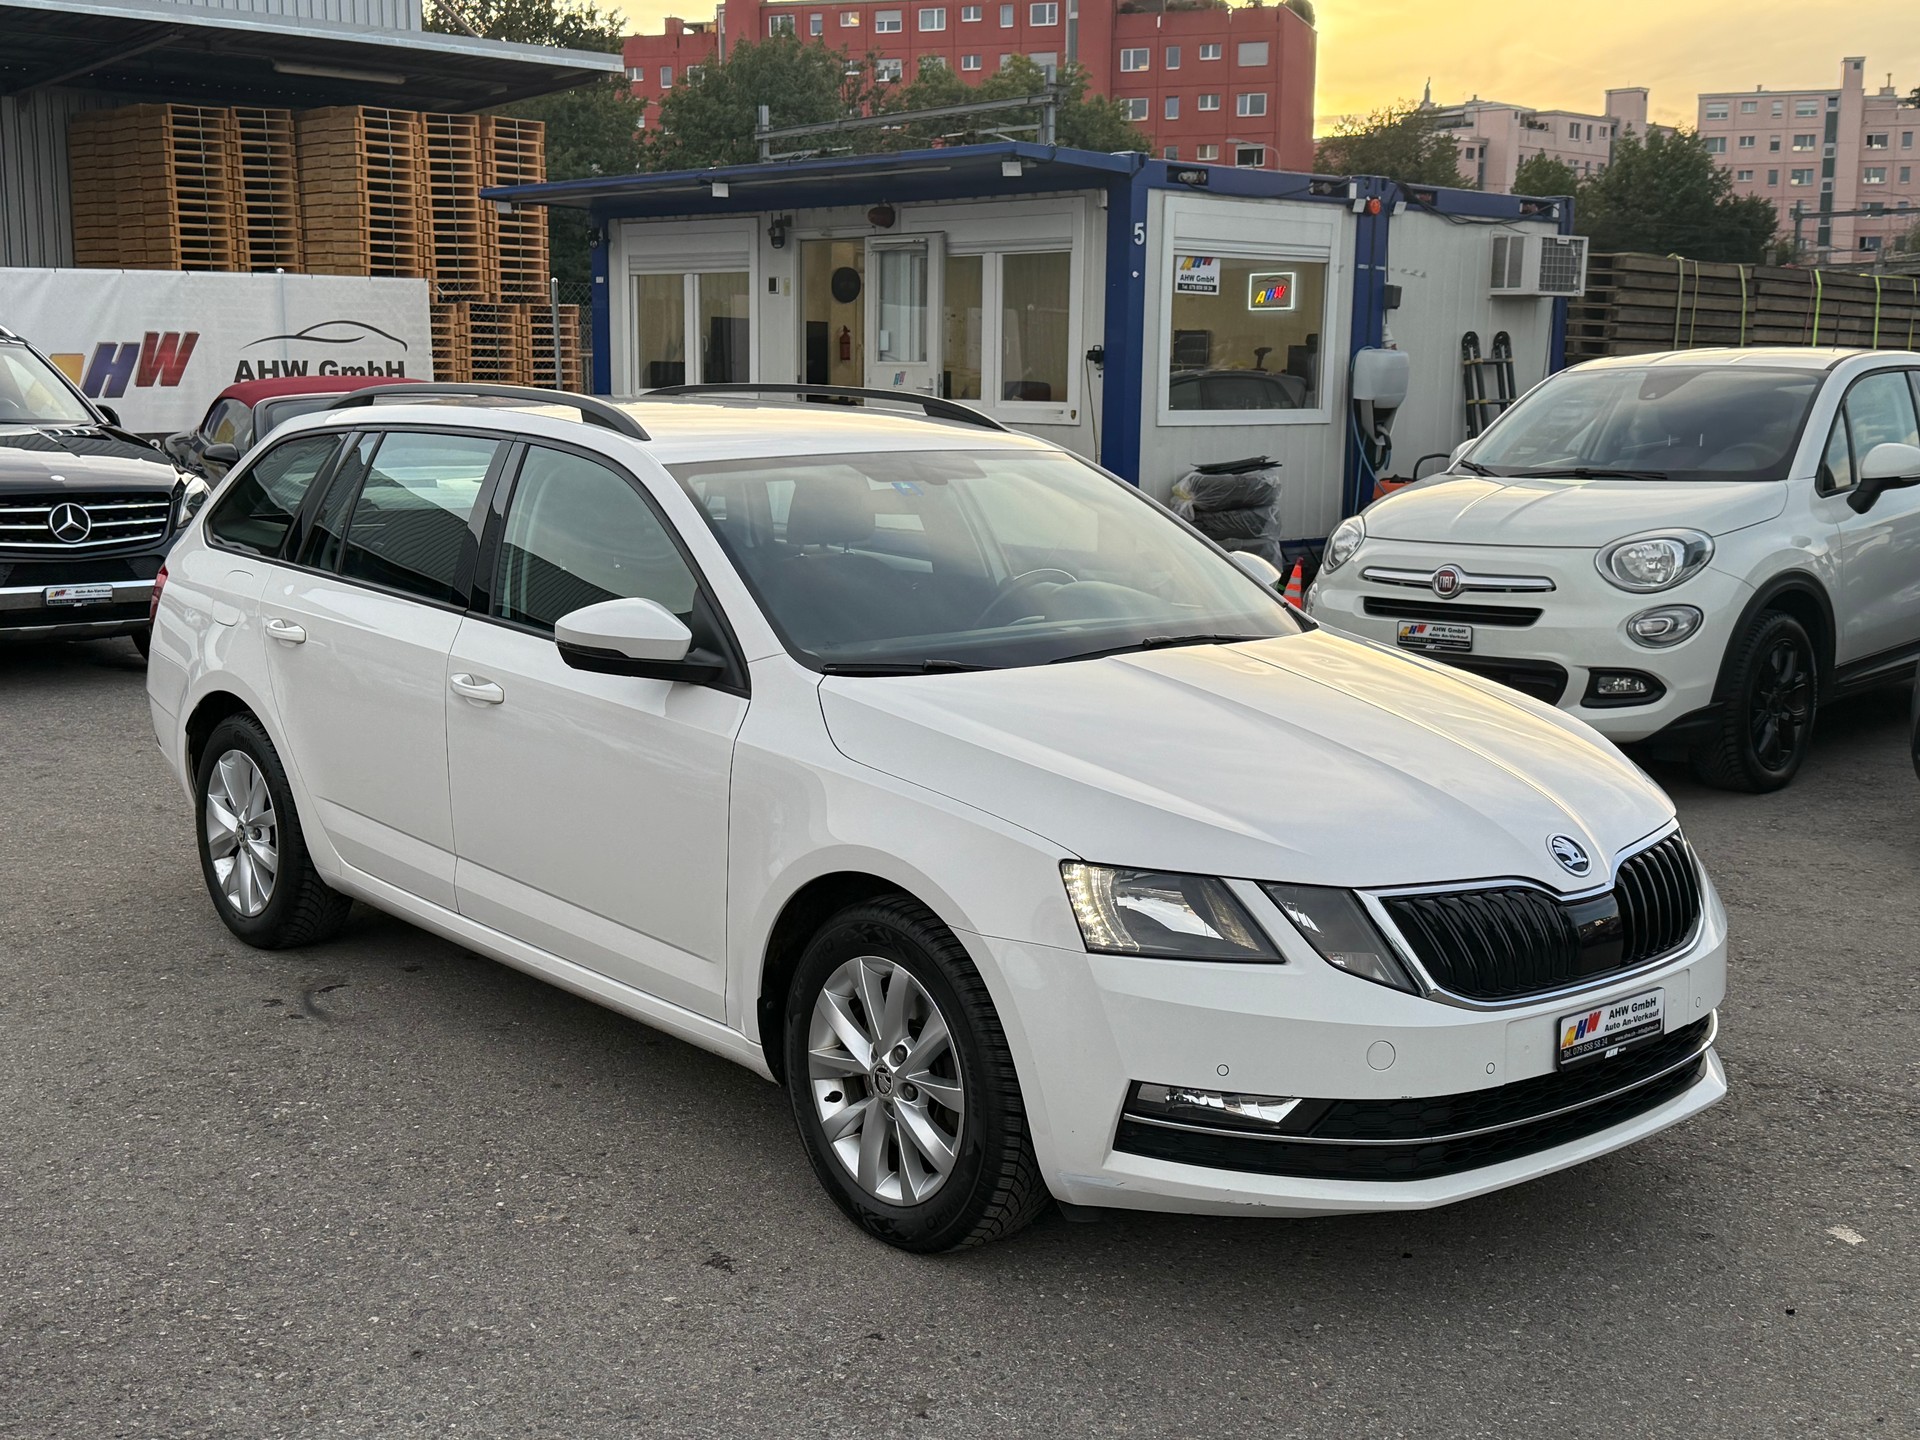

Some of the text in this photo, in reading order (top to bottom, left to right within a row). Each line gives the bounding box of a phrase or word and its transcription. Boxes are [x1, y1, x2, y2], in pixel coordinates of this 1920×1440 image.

[1134, 222, 1145, 245] 5
[1180, 273, 1215, 283] AHW GmbH
[1255, 285, 1287, 304] AHW
[234, 360, 405, 383] AHW GmbH
[1439, 575, 1454, 589] FIAT
[1608, 997, 1657, 1020] AHW GmbH
[1562, 1011, 1602, 1048] AHW
[1604, 1008, 1660, 1033] Auto An-Verkauf
[1563, 1049, 1572, 1058] Tel.
[1573, 1045, 1582, 1055] 079
[1583, 1042, 1594, 1052] 858
